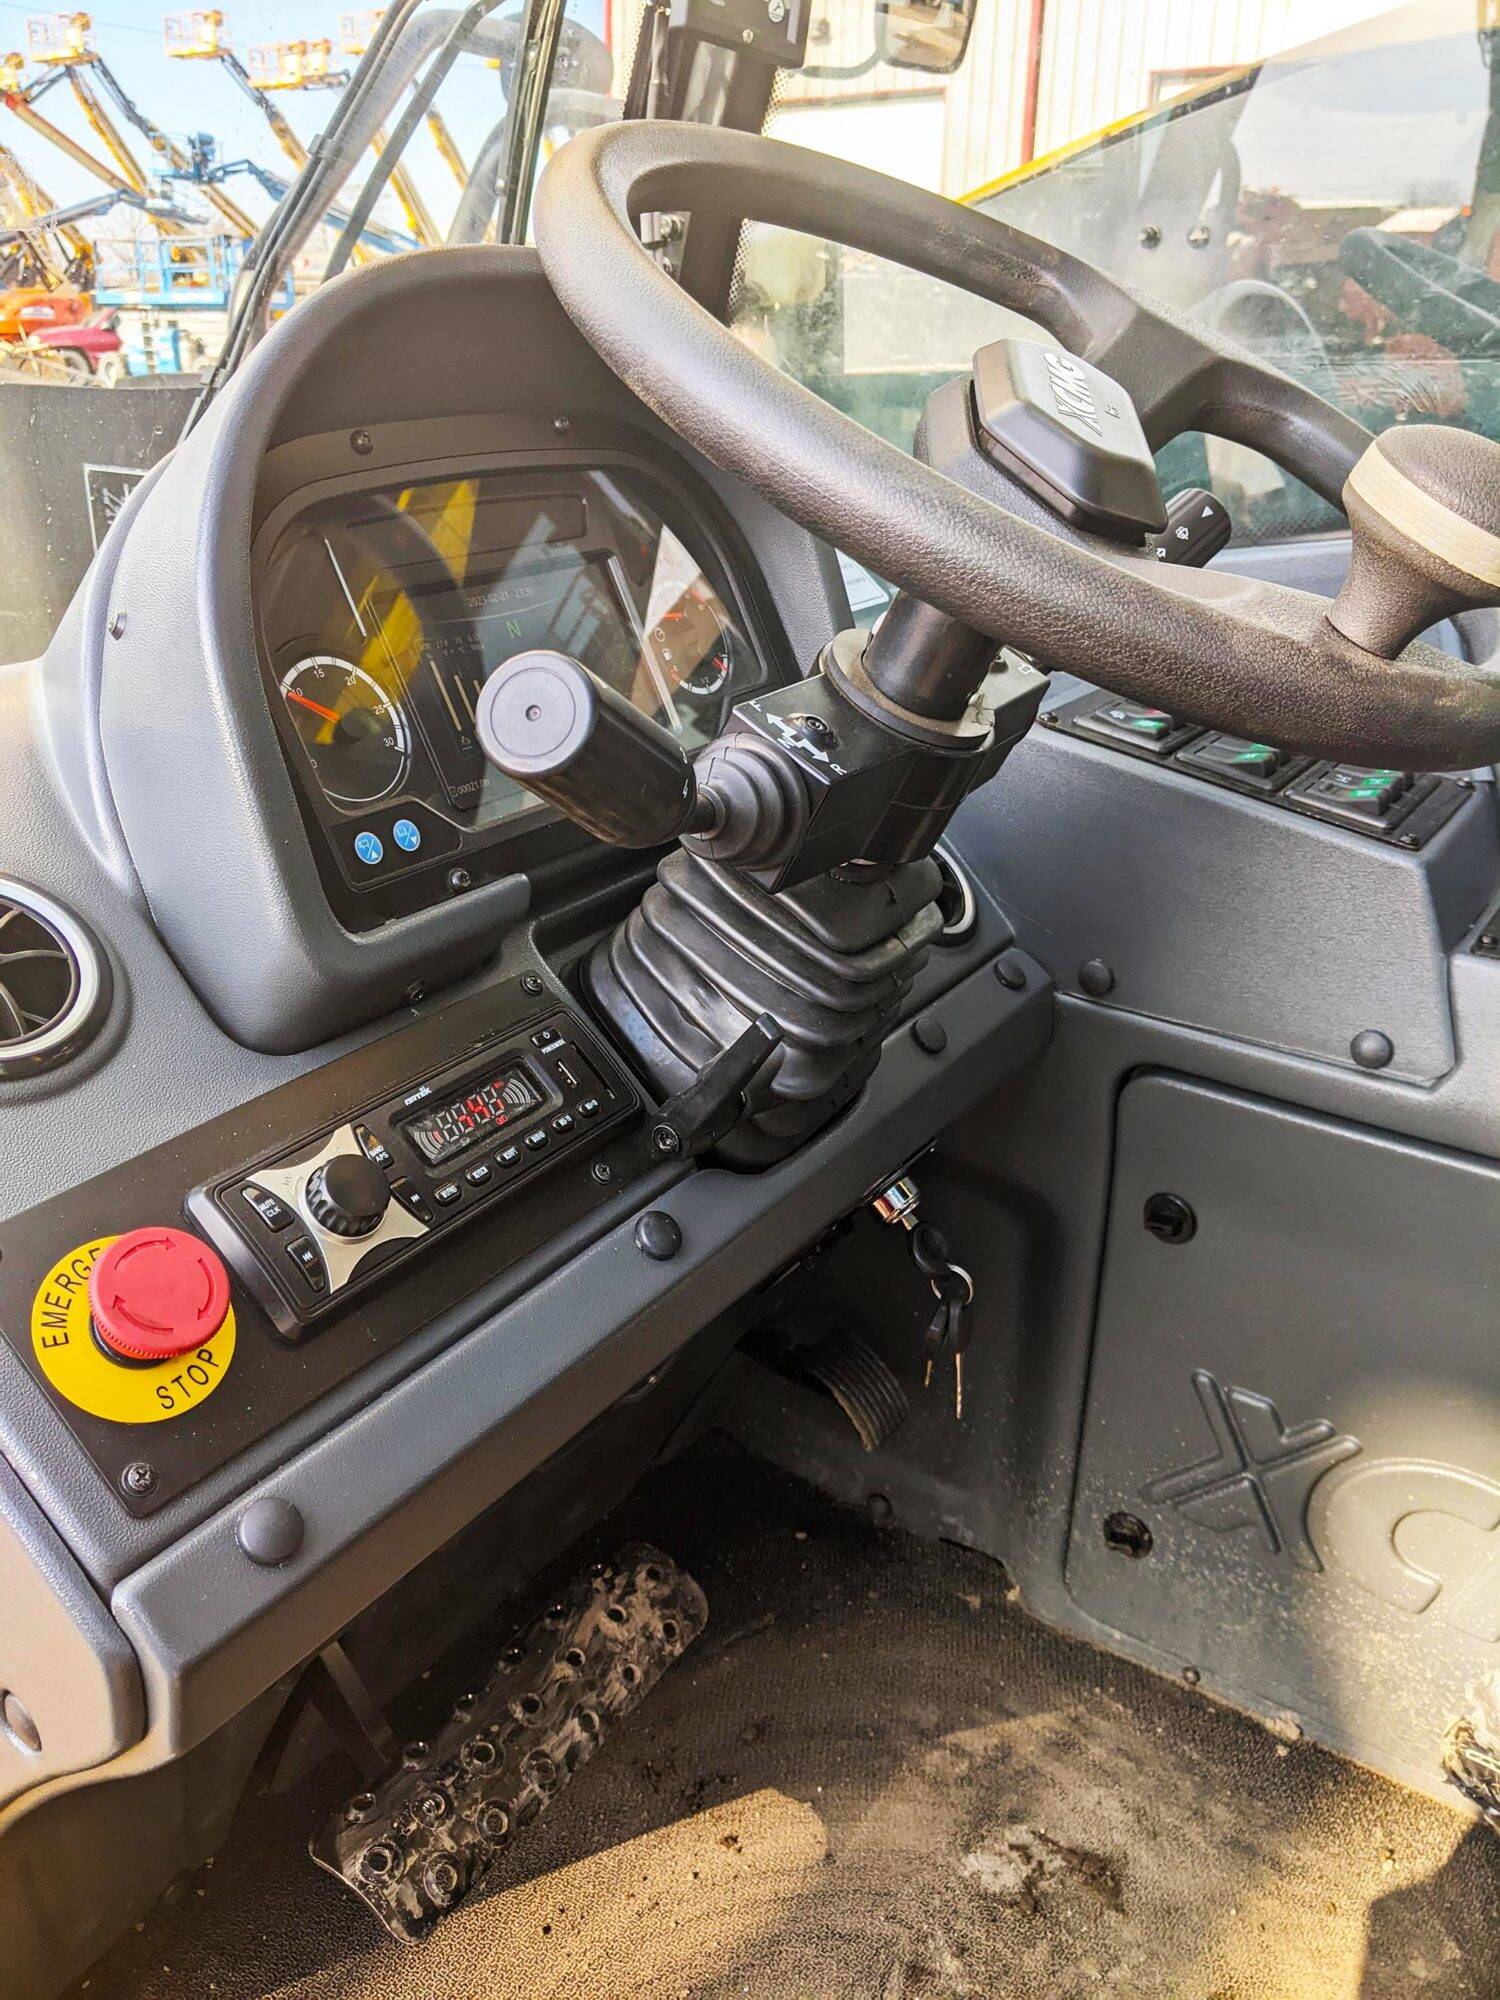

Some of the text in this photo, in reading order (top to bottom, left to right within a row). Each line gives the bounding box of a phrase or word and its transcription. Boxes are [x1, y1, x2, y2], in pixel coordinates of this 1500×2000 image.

[1043, 352, 1103, 437] XCMG
[506, 619, 521, 638] N
[313, 669, 325, 679] 15
[344, 675, 357, 686] 20
[373, 705, 385, 715] 25
[749, 700, 763, 712] F
[383, 737, 394, 747] 30
[829, 763, 848, 776] R
[368, 1145, 384, 1158] BAND
[375, 1151, 389, 1163] APS
[257, 1198, 276, 1211] MUTE
[266, 1205, 282, 1217] CLK
[156, 1348, 219, 1410] STOP
